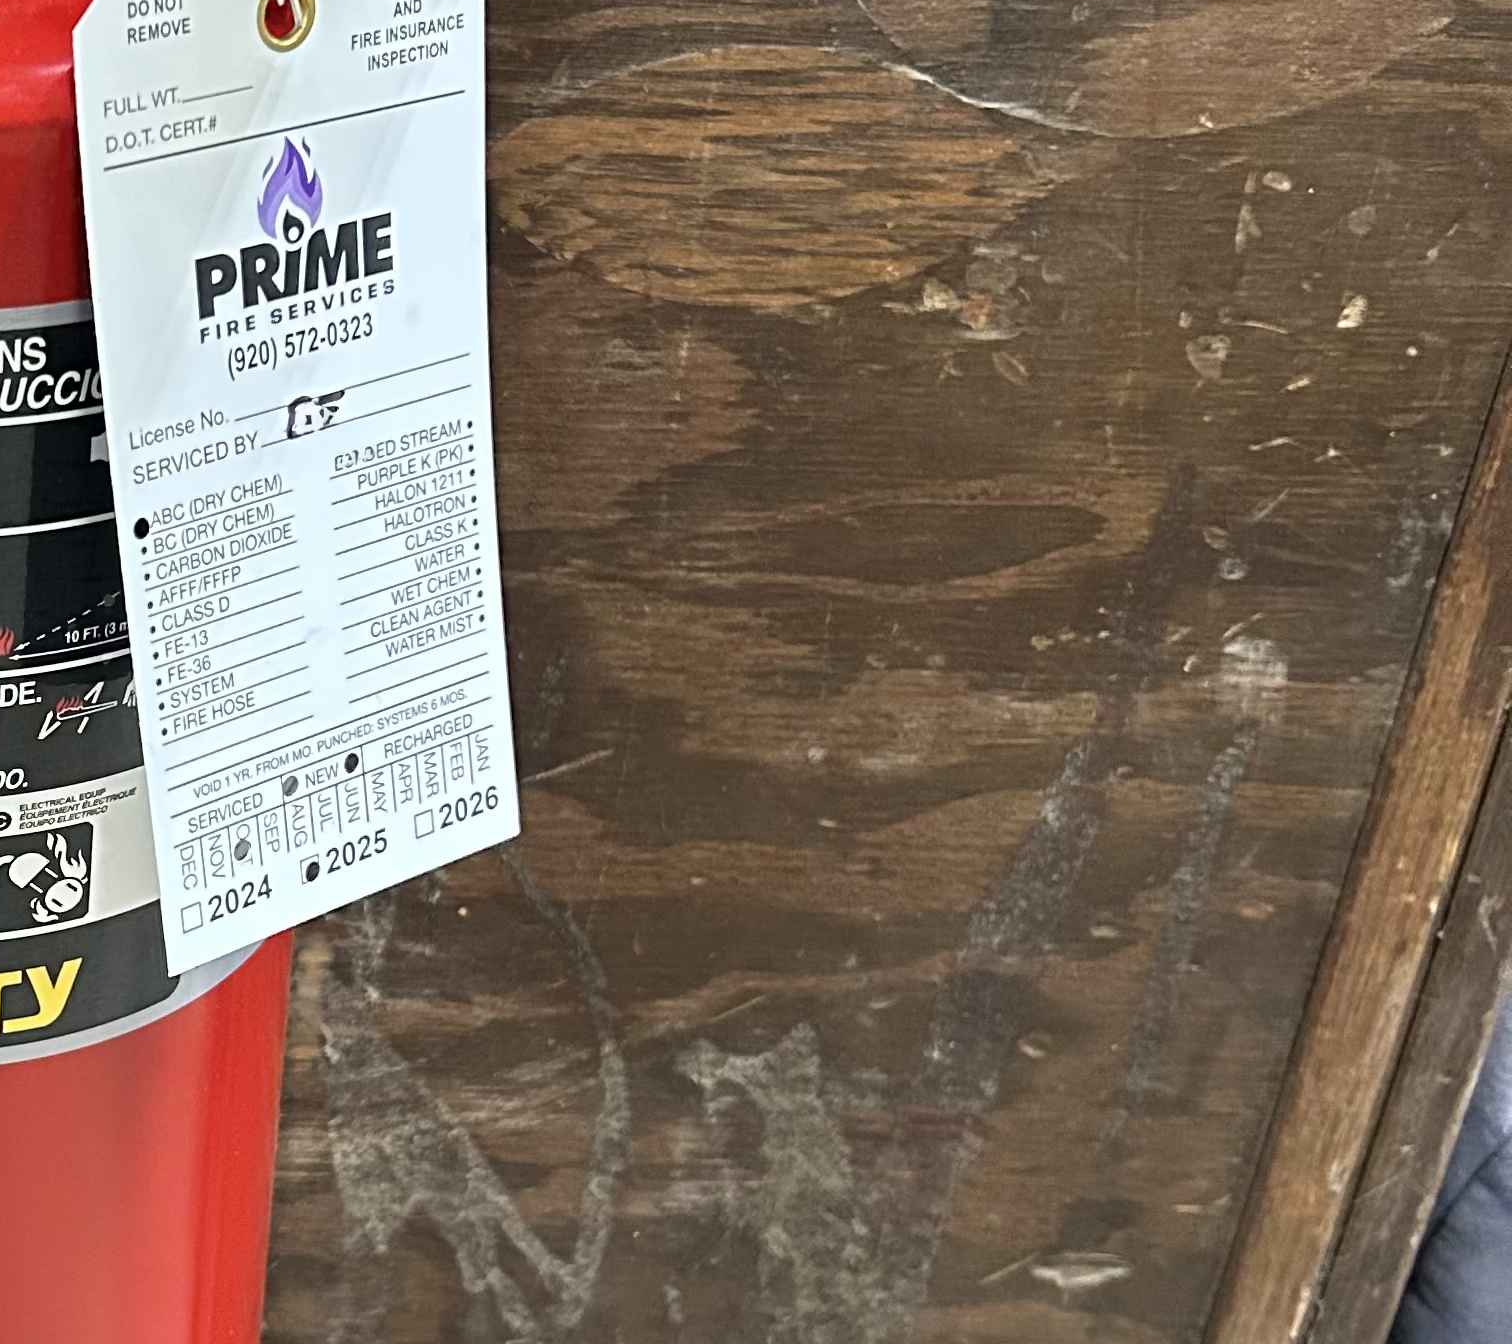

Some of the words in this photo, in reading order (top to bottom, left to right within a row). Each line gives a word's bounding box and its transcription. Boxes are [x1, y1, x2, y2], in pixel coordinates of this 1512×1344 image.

[127, 1, 149, 19] DO
[127, 18, 191, 45] REMOVE
[351, 30, 381, 51] FIRE
[386, 13, 464, 43] INSURANCE
[368, 40, 448, 71] INSPECTION
[104, 92, 147, 119] FULL
[151, 87, 182, 107] WT.
[105, 129, 155, 154] D.O.T.
[160, 115, 217, 142] CERT.#
[200, 315, 255, 344] FIRE
[270, 279, 395, 324] SERVICES
[228, 337, 277, 381] (920)
[285, 312, 373, 358] 572-0323
[129, 417, 195, 450] License
[200, 409, 230, 431] No.
[400, 419, 462, 451] STREAM
[133, 441, 229, 484] SERVICED
[234, 431, 258, 455] BY
[358, 457, 416, 490] PURPLE
[421, 453, 431, 471] K
[435, 444, 463, 467] (PK)
[150, 503, 185, 529] ABC
[189, 490, 226, 521] (DRY
[230, 473, 283, 504] CHEM)
[375, 481, 427, 510] HALON
[432, 469, 463, 492] 1211
[153, 533, 177, 554] BC
[181, 521, 218, 551] (DRY
[222, 502, 275, 532] CHEM)
[384, 494, 466, 533] HALOTRON
[156, 544, 225, 580] CARBON
[230, 523, 292, 556] DIOXIDE
[405, 523, 453, 551] CLASS
[457, 518, 468, 534] K
[414, 543, 465, 572] WATER
[159, 565, 241, 606] AFFF/FFFP
[390, 582, 422, 606] WET
[427, 566, 471, 593] CHEM
[162, 600, 214, 632] CLASS
[218, 596, 230, 613] D
[370, 607, 419, 637] CLEAN
[424, 589, 472, 620] AGENT
[164, 629, 209, 659] FE-13
[385, 627, 436, 657] WATER
[439, 614, 473, 639] MIST
[167, 655, 212, 684] FE-36
[170, 672, 235, 708] SYSTEM
[173, 708, 207, 734] FIRE
[212, 691, 256, 720] HOSE
[450, 742, 464, 781] FEB
[475, 733, 490, 772] JAN
[188, 792, 263, 834] SERVICED
[305, 763, 338, 789] NEW
[384, 713, 473, 759] RECHARGED
[371, 771, 388, 813] MAY
[398, 762, 413, 804] APR
[424, 751, 438, 798] MAR
[317, 793, 335, 833] JUL
[345, 783, 360, 824] JUN
[439, 785, 499, 829] 2026
[263, 812, 280, 853] SEP
[292, 803, 308, 848] AUG
[179, 845, 198, 890] DEC
[208, 834, 225, 878] NOV
[326, 827, 388, 874] 2025
[207, 874, 273, 923] 2024
